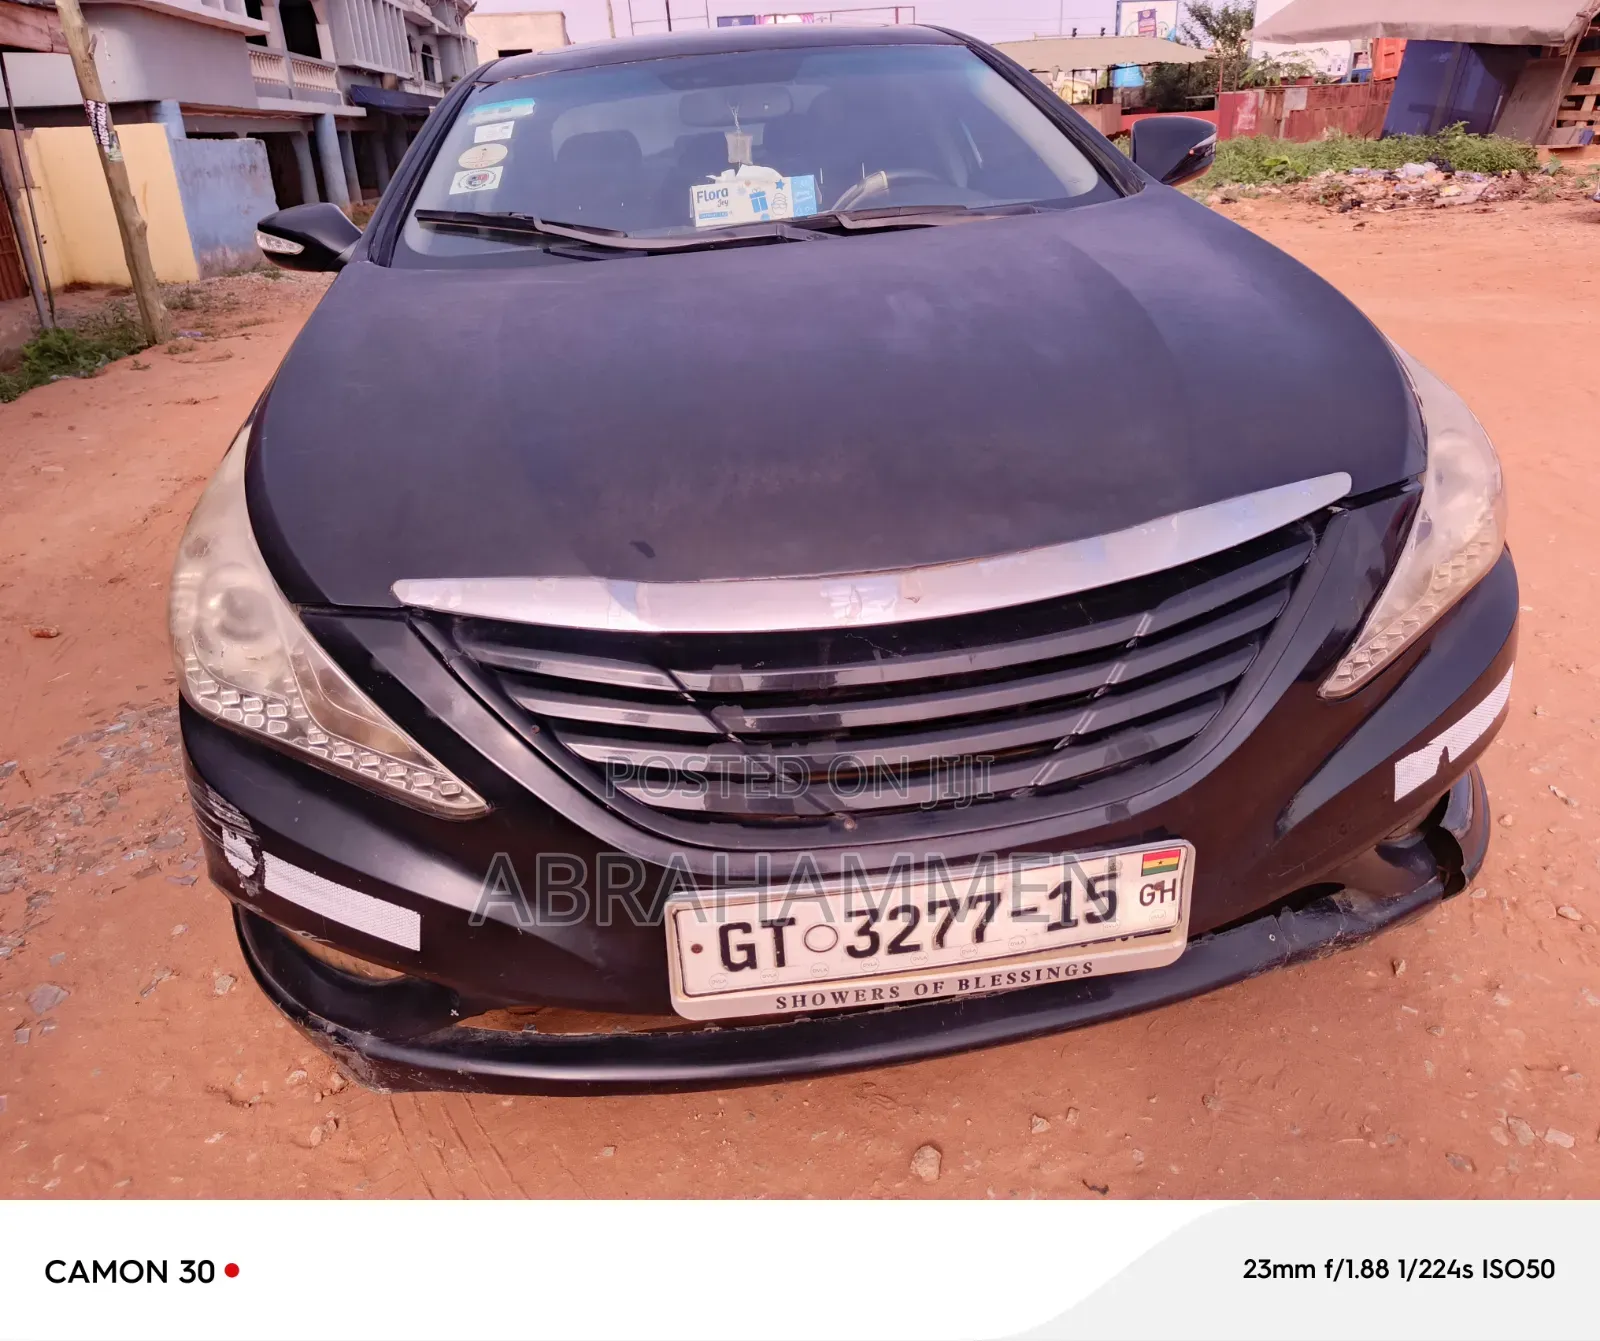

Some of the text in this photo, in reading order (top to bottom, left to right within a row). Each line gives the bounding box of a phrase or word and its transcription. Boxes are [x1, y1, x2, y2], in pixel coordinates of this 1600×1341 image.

[696, 187, 729, 204] Flora
[1139, 879, 1178, 907] GH
[718, 916, 797, 973] GT
[776, 961, 1094, 1010] SHOWERS OF BLESSINGS
